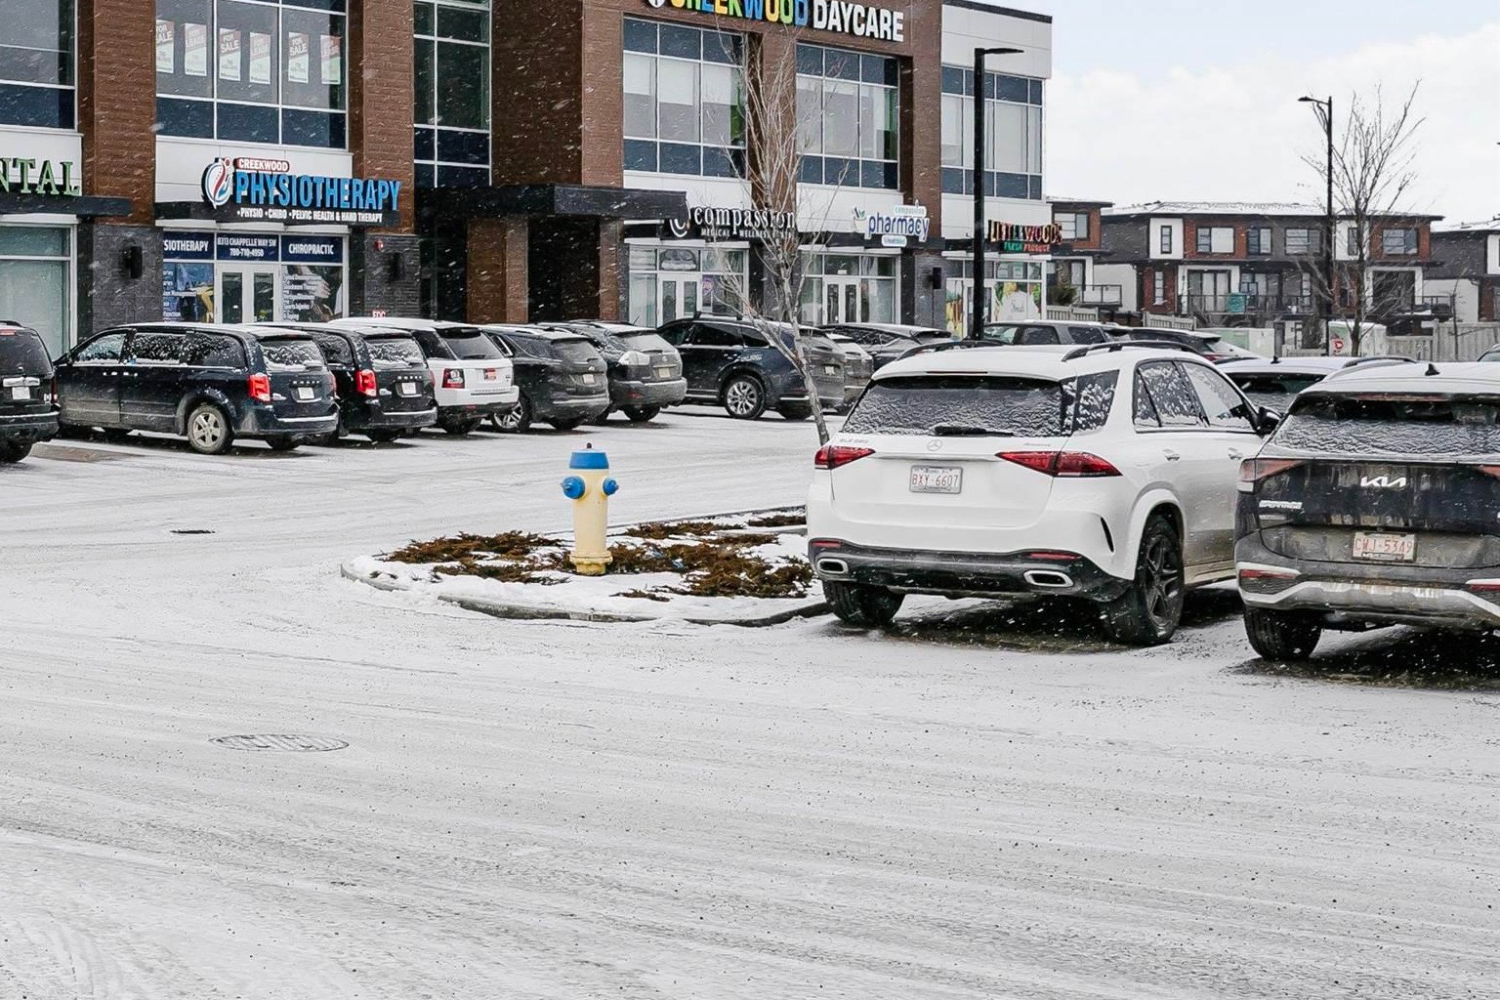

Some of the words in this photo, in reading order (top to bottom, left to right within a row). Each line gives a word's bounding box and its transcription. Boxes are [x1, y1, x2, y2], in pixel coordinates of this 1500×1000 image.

[220, 40, 240, 53] SALE
[290, 43, 308, 56] SALE
[238, 157, 289, 172] CREEKWOOD
[235, 171, 402, 211] PHYSIOTHERAPY
[240, 207, 263, 218] PHYSIO
[868, 211, 930, 241] pharmacy
[162, 238, 209, 253] SIOTHERAPY
[229, 237, 257, 247] CHAPPELLE
[288, 243, 335, 256] CHIROPRACTIC
[1360, 476, 1407, 487] KIA
